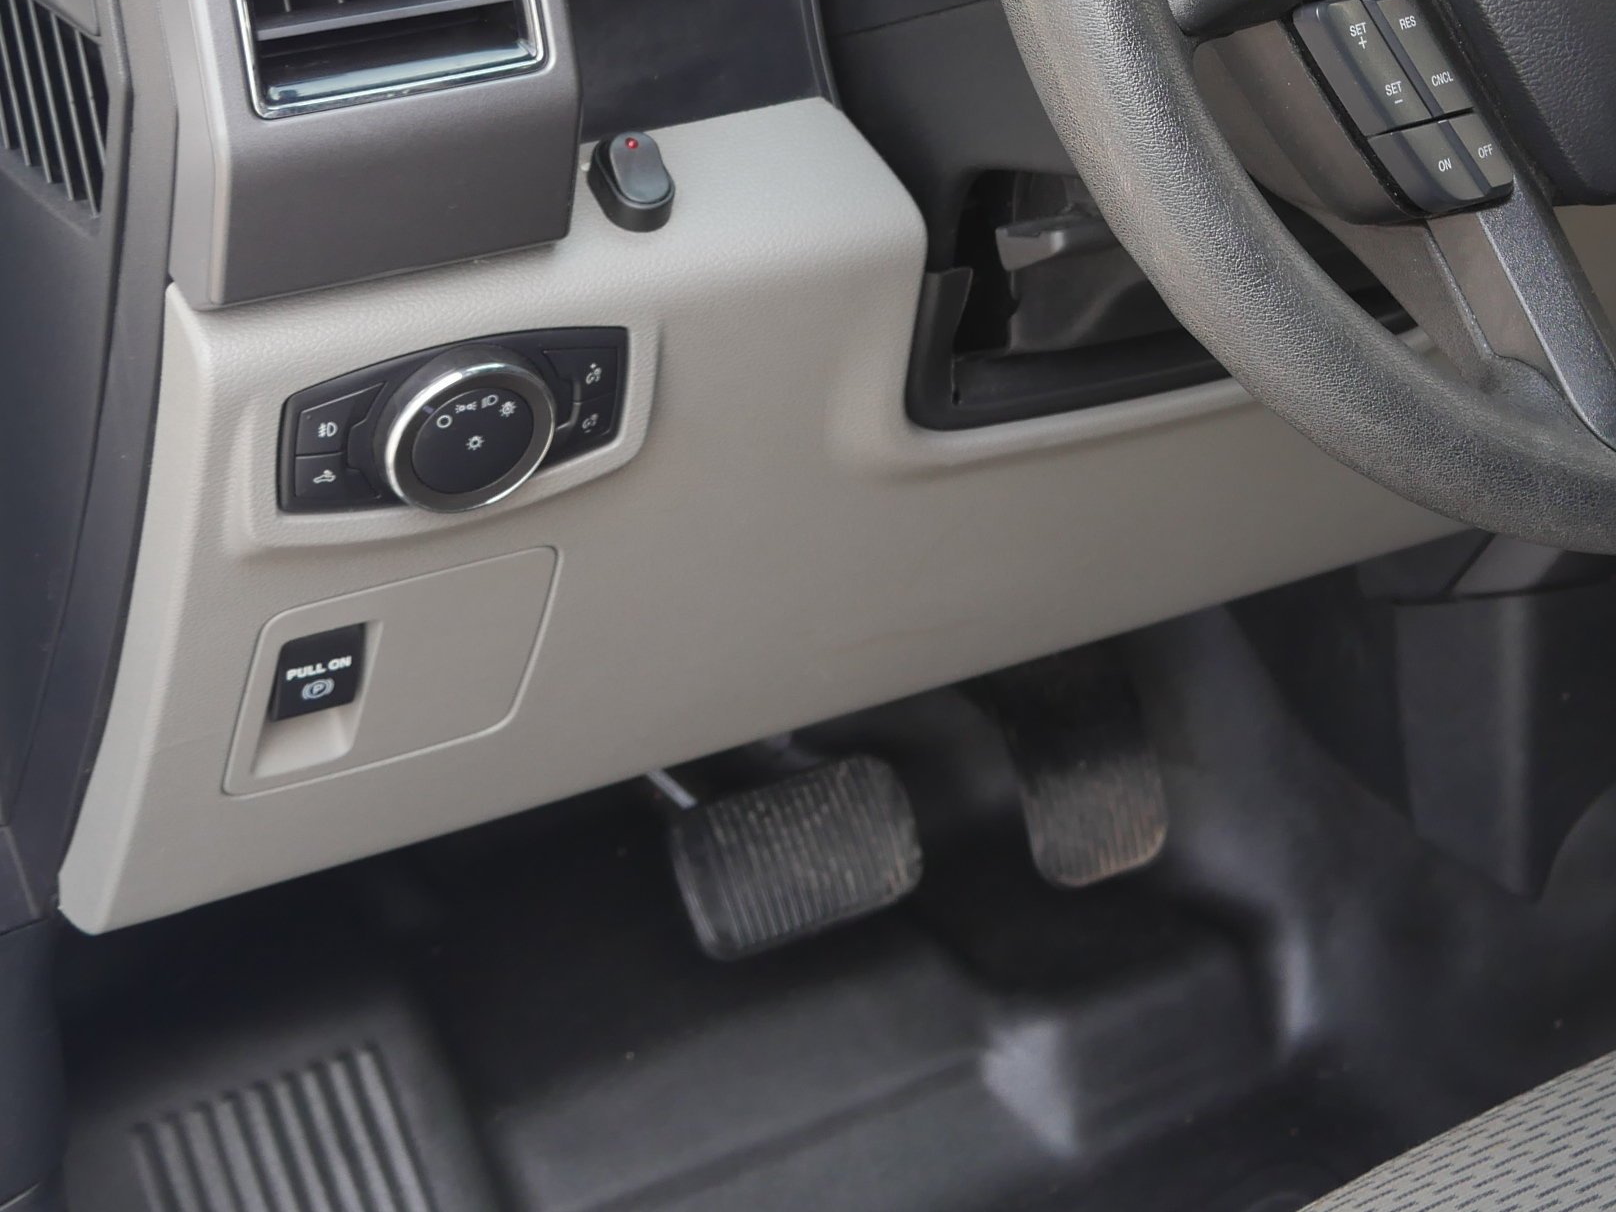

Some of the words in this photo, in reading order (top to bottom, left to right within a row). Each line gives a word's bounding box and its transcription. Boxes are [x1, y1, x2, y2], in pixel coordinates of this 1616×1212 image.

[1349, 22, 1367, 37] SET
[1399, 15, 1417, 31] RES
[1431, 71, 1454, 87] CNCL
[1385, 81, 1403, 96] SET
[1478, 143, 1494, 158] OFF
[1438, 158, 1452, 173] ON
[286, 663, 327, 681] PULL
[328, 655, 352, 672] ON
